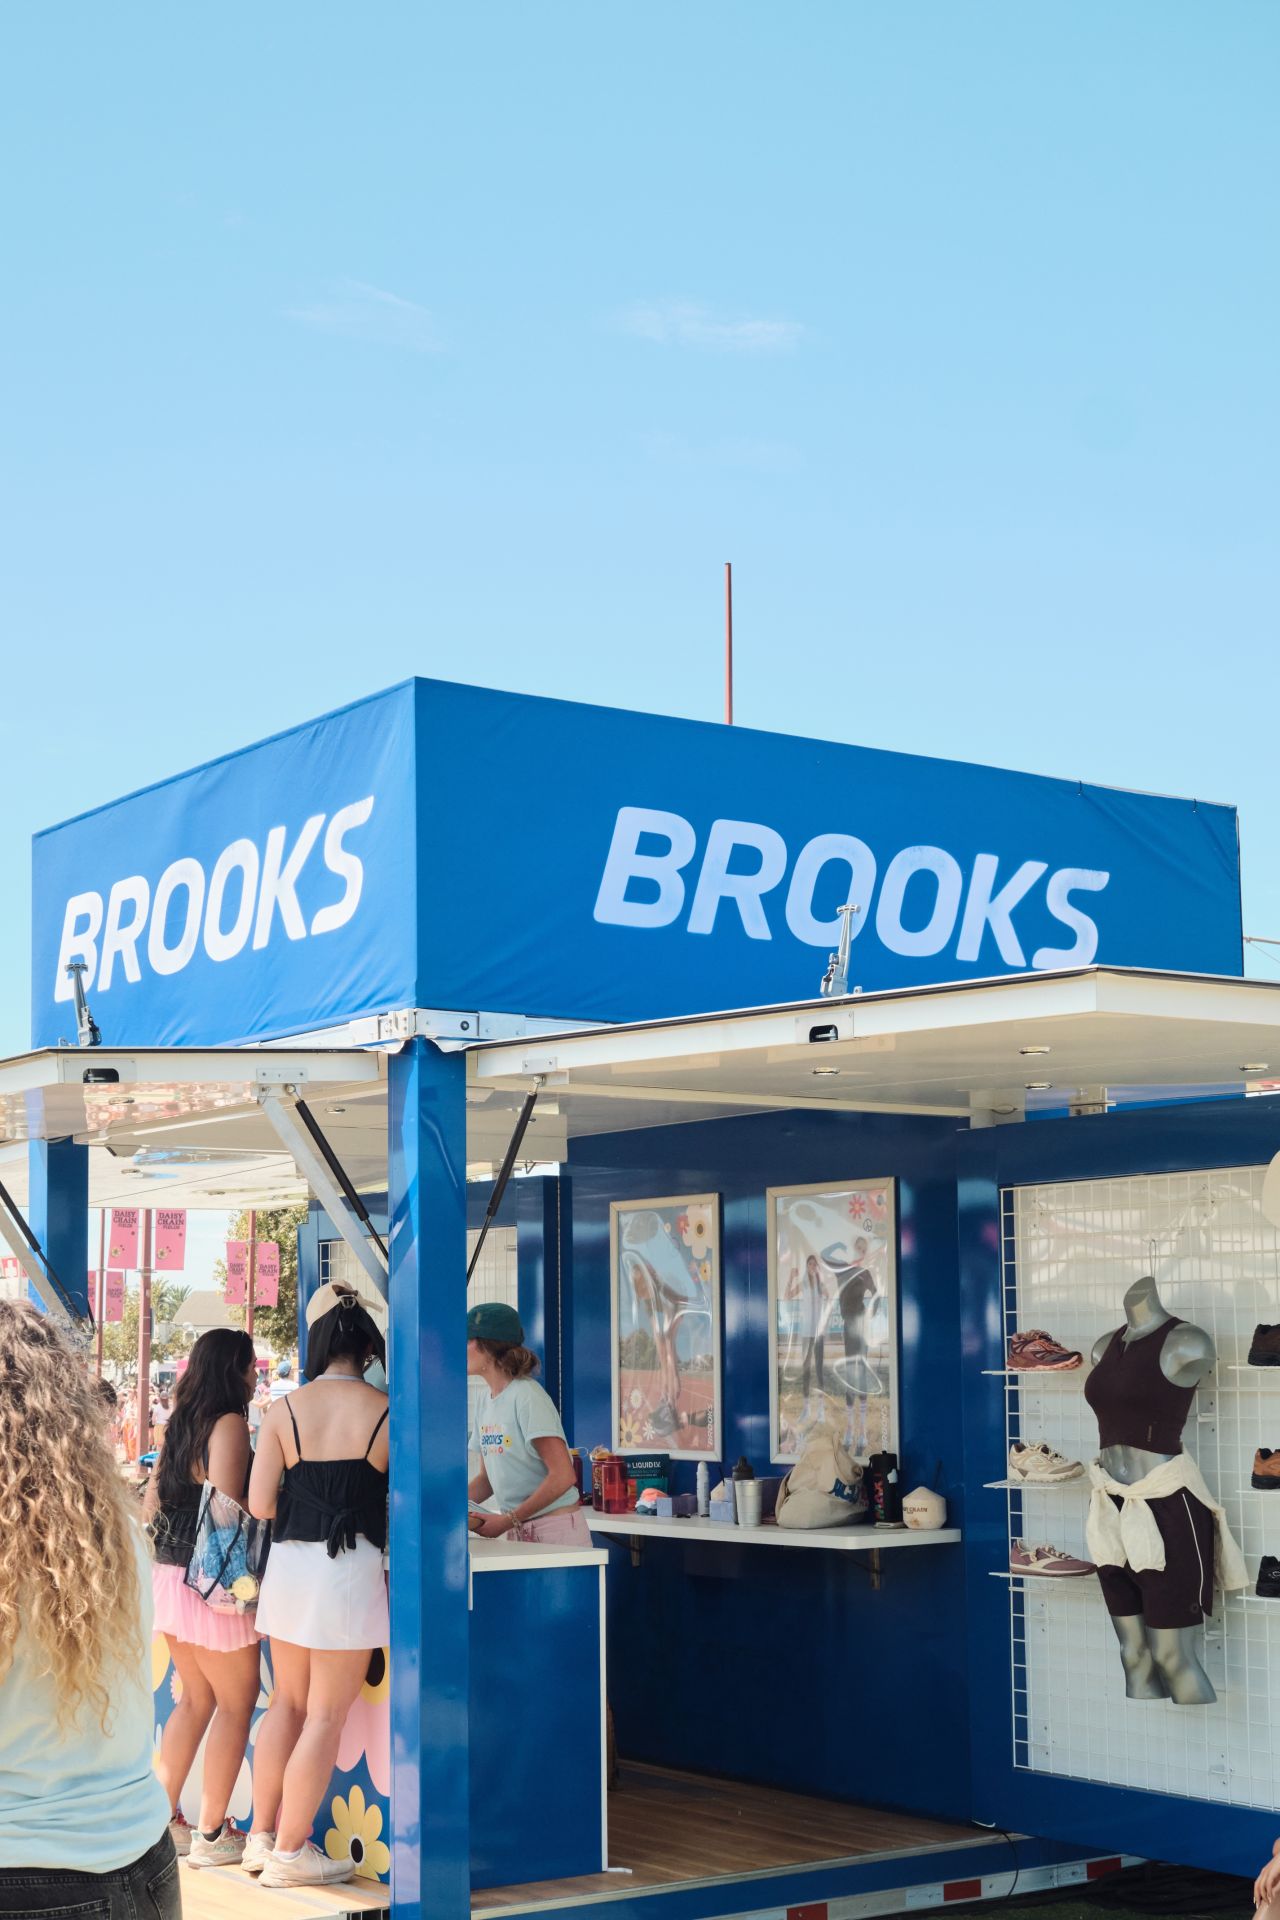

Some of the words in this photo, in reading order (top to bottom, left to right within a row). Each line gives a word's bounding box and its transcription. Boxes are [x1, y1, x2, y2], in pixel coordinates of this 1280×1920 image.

[54, 795, 375, 1003] BROOKS
[593, 806, 1110, 970] BROOKS
[114, 1210, 136, 1218] DAISY
[632, 1461, 654, 1469] LIQUID
